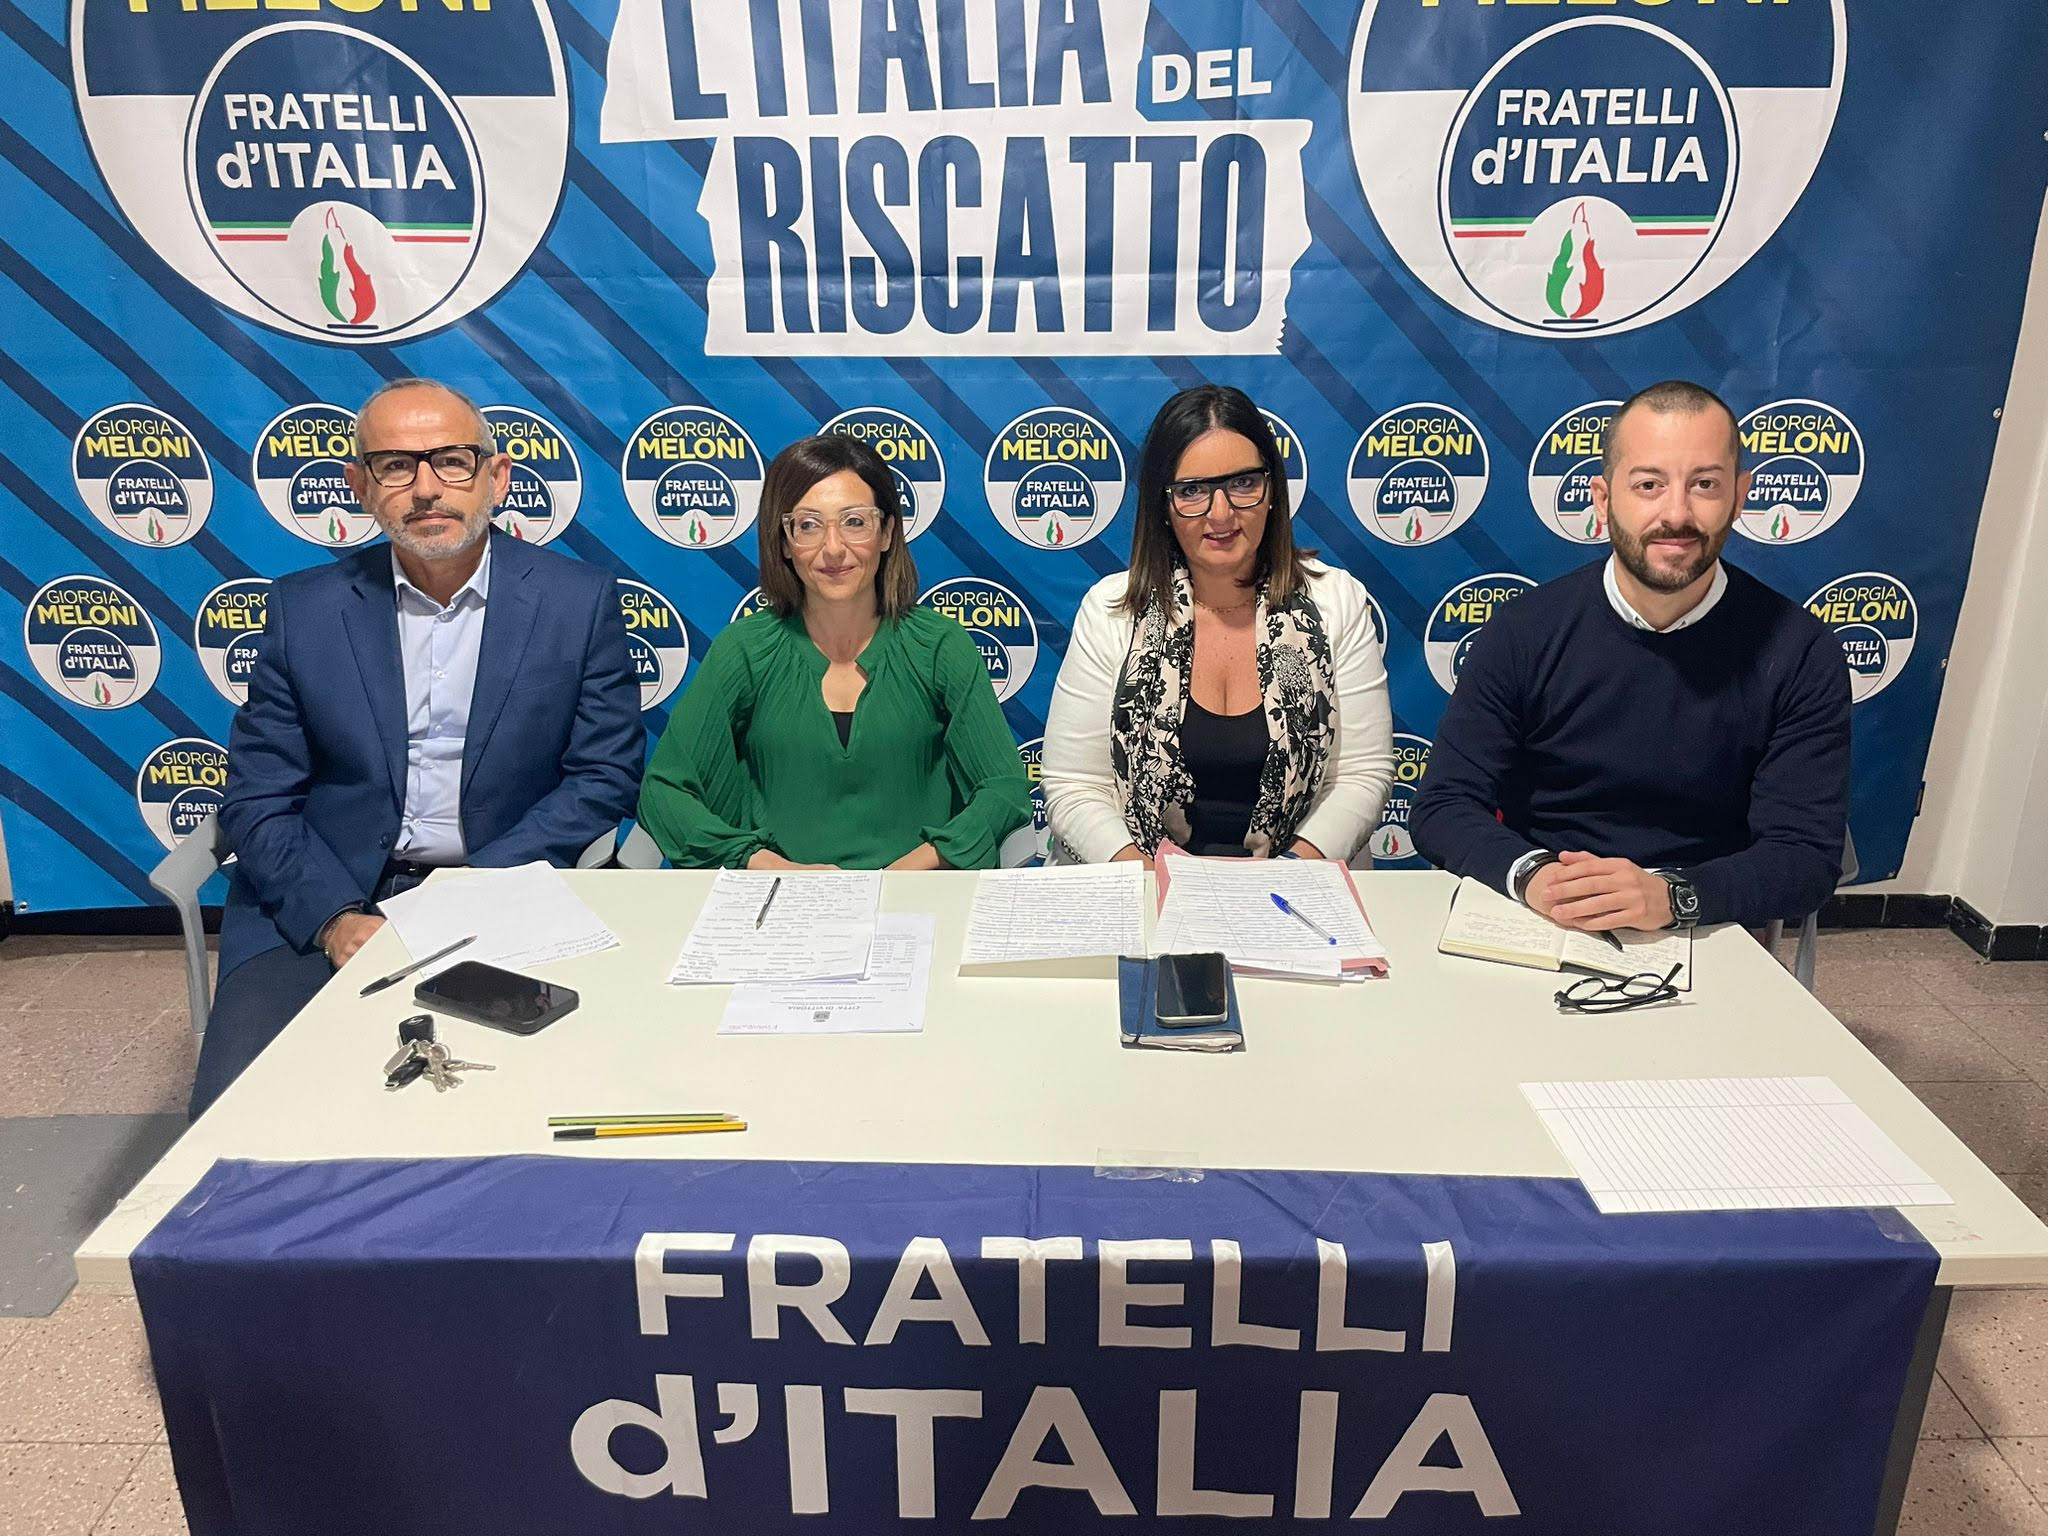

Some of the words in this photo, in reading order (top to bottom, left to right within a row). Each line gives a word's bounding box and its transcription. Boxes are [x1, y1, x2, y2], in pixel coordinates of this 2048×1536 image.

[1151, 47, 1272, 104] DEL
[224, 93, 427, 132] FRATELLI
[1497, 87, 1699, 127] FRATELLI
[217, 142, 456, 190] d'ITALIA
[1472, 136, 1709, 185] d'ITALIA
[733, 134, 1267, 334] RISCATTO
[95, 420, 173, 437] GIORGIA
[488, 422, 544, 438] ORGIA
[650, 421, 730, 438] GIORGIA
[833, 423, 911, 438] GIORGIA
[1015, 422, 1094, 438] GIORGIA
[1382, 418, 1460, 435] GIORGIA
[1752, 415, 1836, 431] GIORGIA
[85, 436, 190, 459] MELONI
[269, 435, 357, 458] MELO
[506, 438, 560, 461] ONI
[638, 437, 745, 460] MELONI
[875, 439, 926, 461] ONI
[1002, 439, 1107, 461] MELONI
[1367, 434, 1473, 457] MELONI
[1551, 433, 1604, 455] MEL
[1740, 431, 1850, 454] MELONI
[118, 477, 174, 490] FRATELLI
[301, 477, 350, 489] FRATEL
[510, 480, 539, 492] ELLI
[665, 480, 724, 491] FRATELLI
[1026, 481, 1084, 493] FRATELLI
[1389, 477, 1446, 488] FRATELLI
[1755, 474, 1819, 486] FRATELLI
[115, 489, 183, 506] d'ITALIA
[297, 490, 360, 504] d'ITALI
[501, 494, 547, 508] ALIA
[661, 492, 731, 507] d'ITALIA
[1021, 494, 1090, 508] d'ITALIA
[1382, 489, 1450, 505] d'ITALIA
[1747, 487, 1822, 501] d'ITALIA
[46, 589, 121, 605] GIORGIA
[932, 591, 1007, 606] GIORGIA
[1825, 586, 1897, 602] GIORGIA
[38, 604, 138, 626] MELONI
[622, 608, 669, 630] ONI
[1810, 600, 1907, 623] MELONI
[67, 643, 122, 656] FRATELLI
[1842, 641, 1880, 651] ATELLI
[64, 655, 130, 671] d'ITALIA
[1847, 653, 1881, 665] ALIA
[160, 751, 228, 766] GIORGIA
[634, 1233, 1456, 1353] FRATELLI
[570, 1373, 1521, 1520] d'ITALIA
